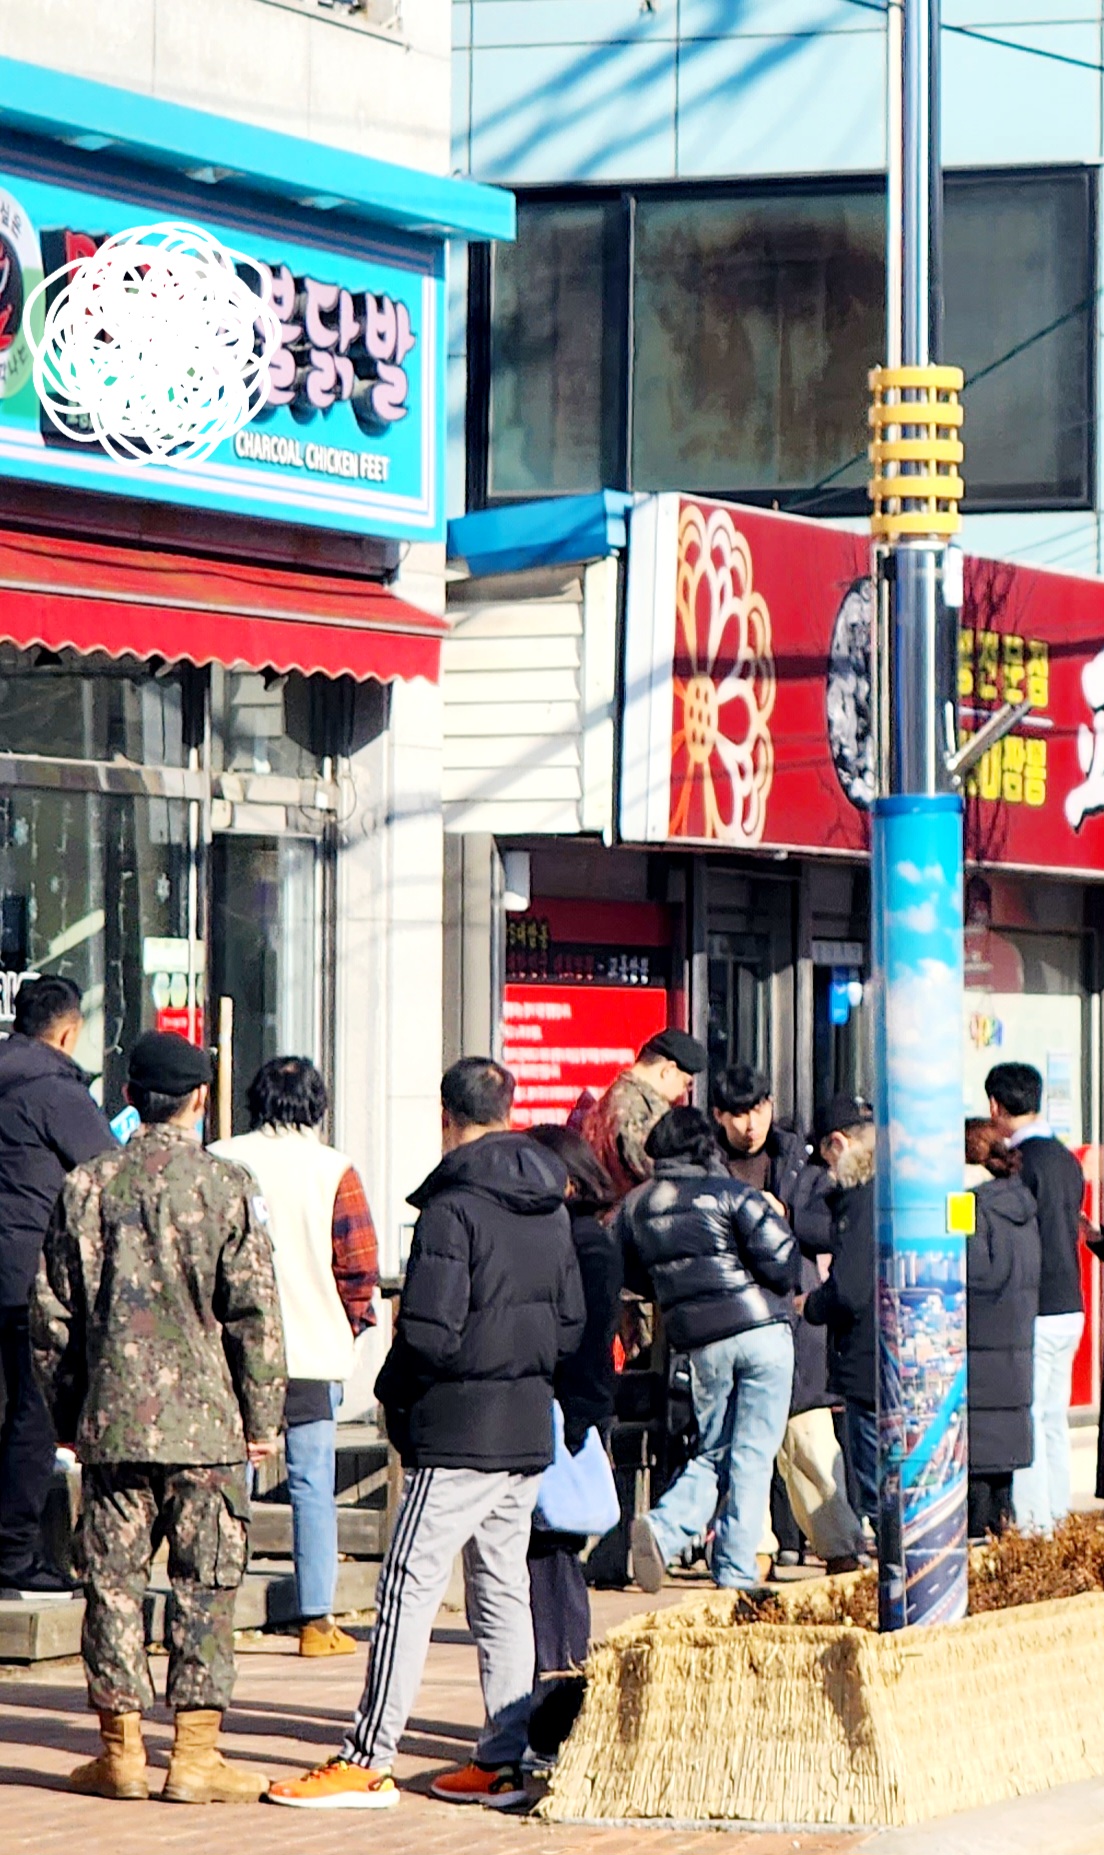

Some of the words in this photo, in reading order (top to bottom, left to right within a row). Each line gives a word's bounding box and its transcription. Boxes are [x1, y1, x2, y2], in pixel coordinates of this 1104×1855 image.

[243, 262, 416, 421] 불닭발
[235, 431, 303, 467] CHARCOAL
[305, 443, 358, 478] CHICKEN
[360, 455, 390, 482] FEET
